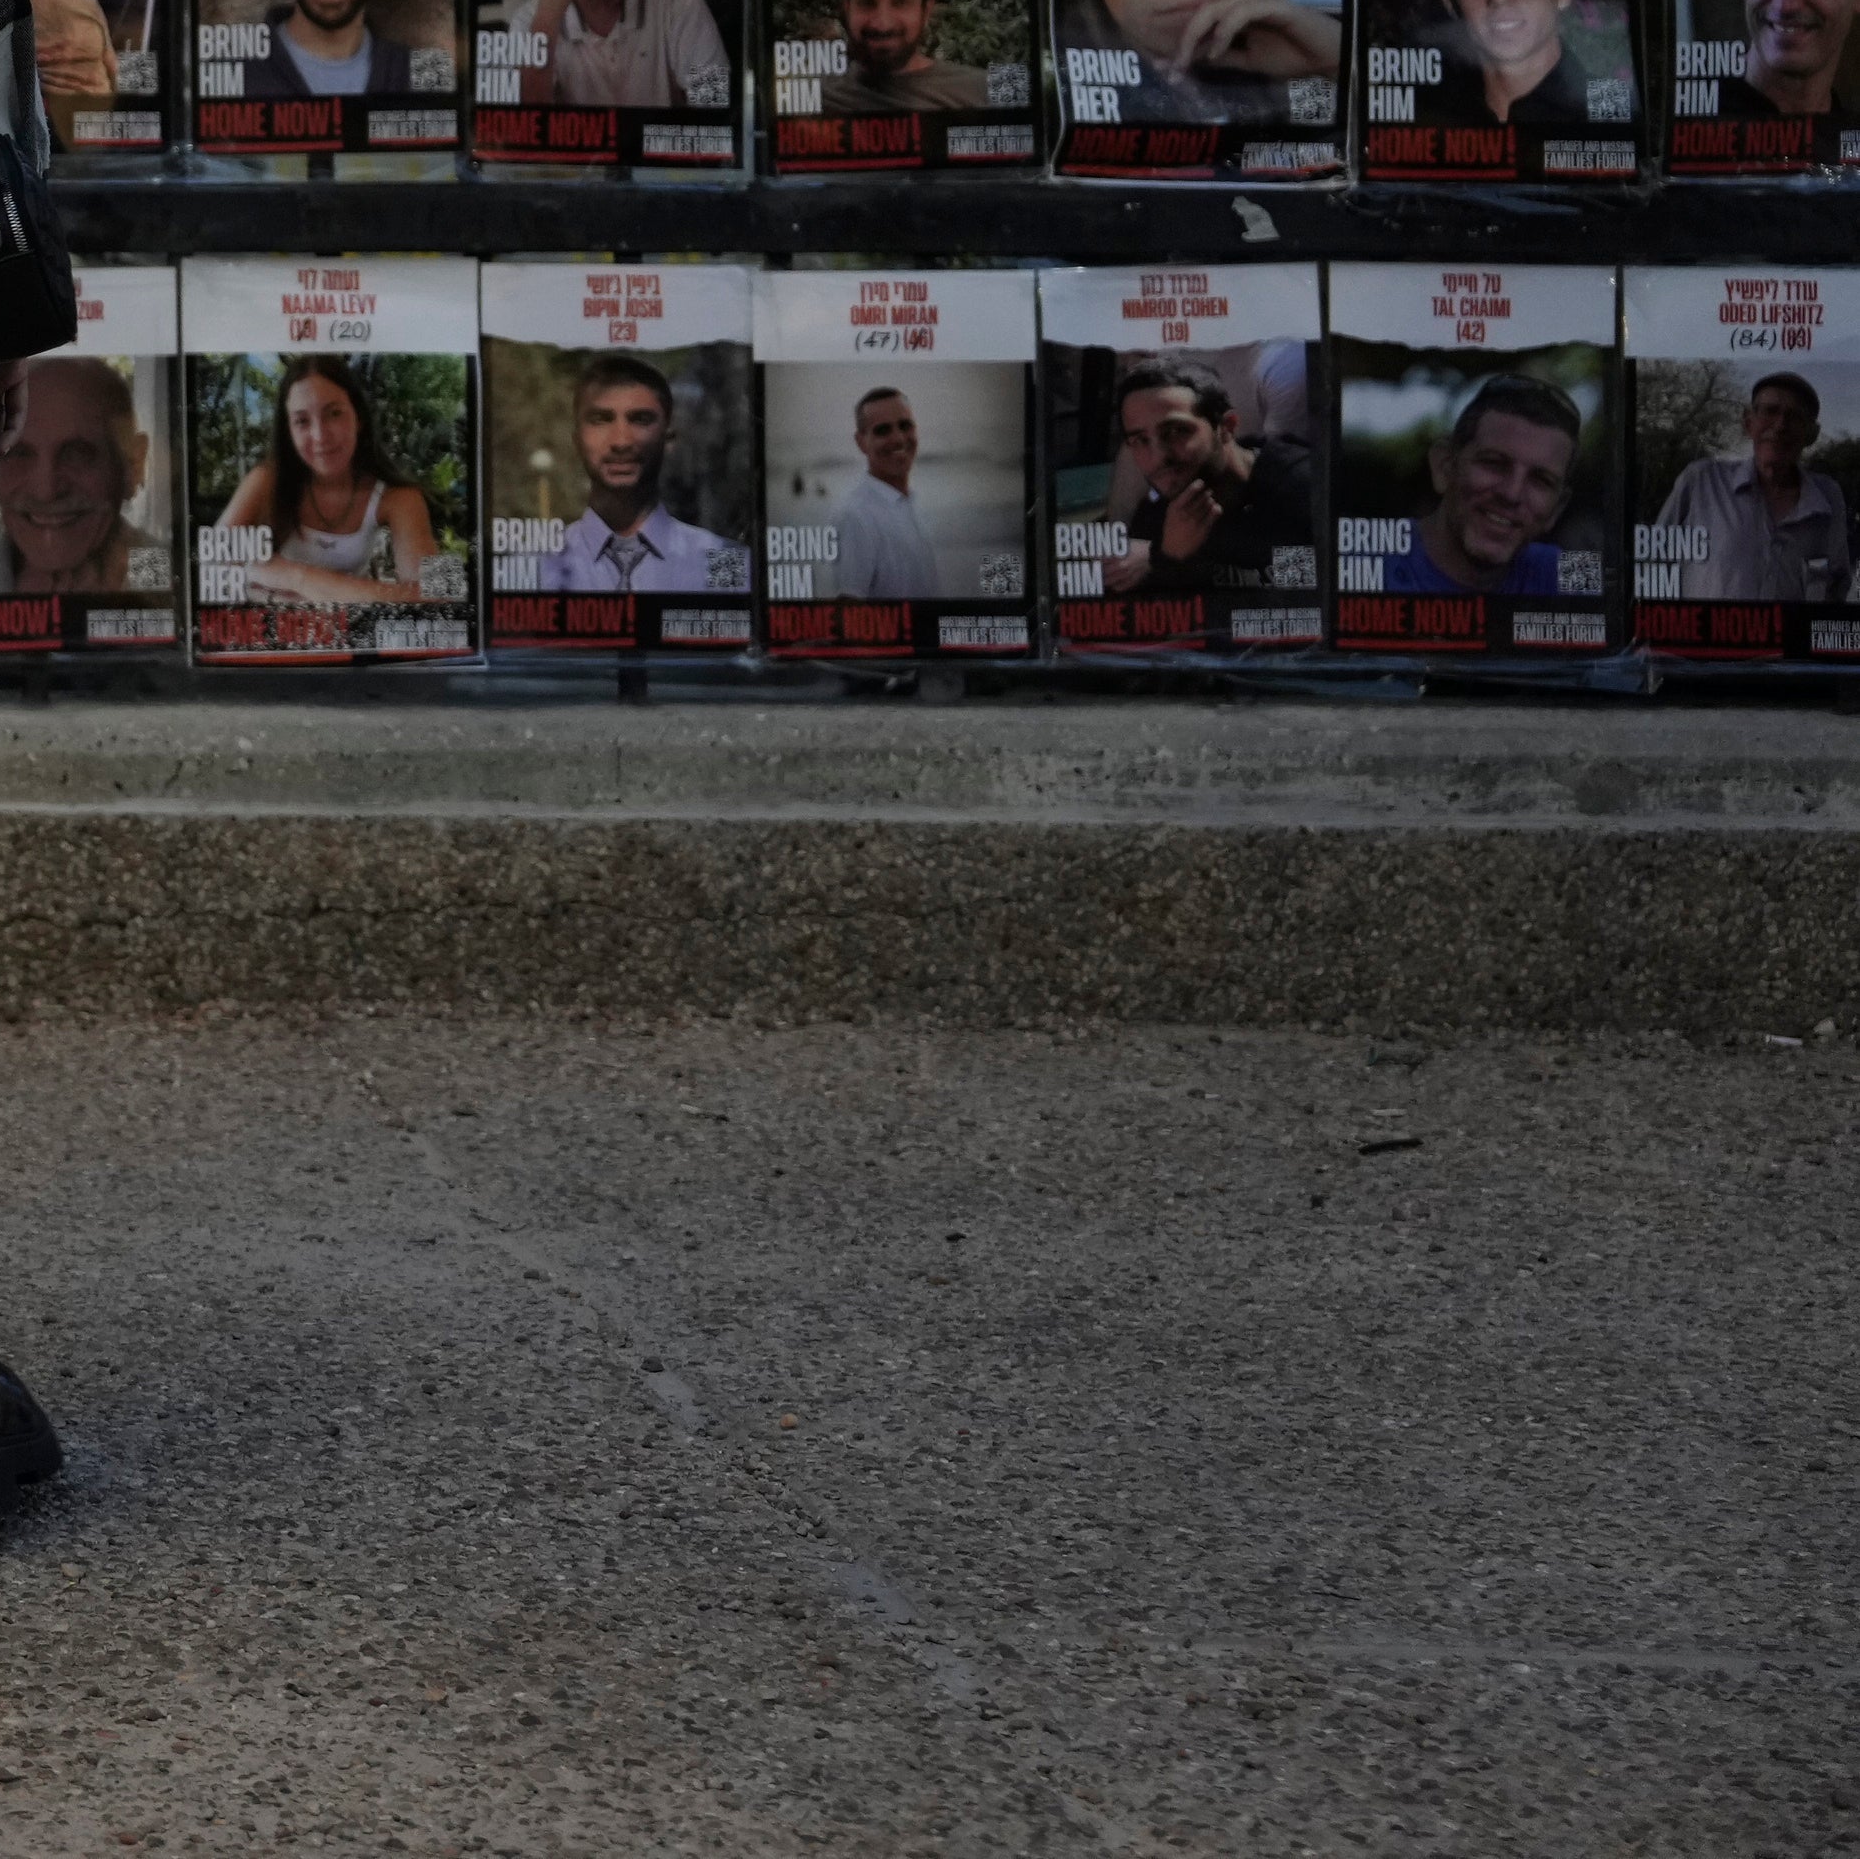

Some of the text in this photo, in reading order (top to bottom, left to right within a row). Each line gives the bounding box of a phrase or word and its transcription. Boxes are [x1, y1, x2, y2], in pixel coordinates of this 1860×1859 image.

[200, 25, 270, 59] BRING
[477, 32, 547, 68] BRING
[776, 40, 847, 76] BRING
[1677, 41, 1745, 77] BRING
[200, 60, 244, 96] HIM
[1067, 47, 1139, 86] BRING
[1369, 48, 1442, 84] BRING
[477, 68, 520, 103] HIM
[776, 77, 822, 113] HIM
[1676, 81, 1718, 115] HIM
[201, 101, 342, 138] HOME NOW!
[1071, 85, 1120, 122] HER
[1369, 87, 1414, 121] HIM
[477, 109, 616, 147] HOME NOW!
[777, 113, 921, 153] HOME NOW!
[1370, 127, 1515, 163] HOME NOW!
[1672, 118, 1814, 158] HOME NOW!
[1544, 152, 1635, 170] FAMILIES FORUM
[1140, 275, 1207, 296] נמרוד כהן
[1442, 273, 1500, 293] טל חיימי
[1725, 281, 1817, 302] עודד ליפשיץ
[282, 294, 376, 314] NAAMA LEVY
[583, 298, 662, 318] BIPIN JOSHI
[850, 305, 938, 326] OMRI MIRAN
[1122, 296, 1227, 319] NIMROD COHEN
[1432, 297, 1510, 317] TAL CHAIMI
[1720, 304, 1823, 325] ODED LIFSHITZ
[329, 319, 372, 342] (20)
[609, 321, 638, 342] (23)
[1162, 321, 1189, 344] (19)
[1456, 320, 1485, 343] (42)
[200, 525, 272, 563] BRING
[493, 518, 564, 553] BRING
[767, 527, 837, 562] BRING
[1056, 523, 1127, 558] BRING
[1339, 518, 1410, 553] BRING
[1635, 524, 1709, 561] BRING
[200, 565, 247, 602] HER
[493, 556, 538, 590] HIM
[767, 564, 812, 598] HIM
[1057, 560, 1103, 596] HIM
[1338, 556, 1383, 591] HIM
[1635, 564, 1680, 598] HIM
[493, 594, 635, 632] HOME NOW!
[769, 601, 911, 639] HOME NOW!
[1059, 596, 1205, 638] HOME NOW!
[1338, 596, 1484, 634] HOME NOW!
[1636, 603, 1781, 640] HOME NOW!
[1514, 624, 1605, 642] FAMILIES FORUM
